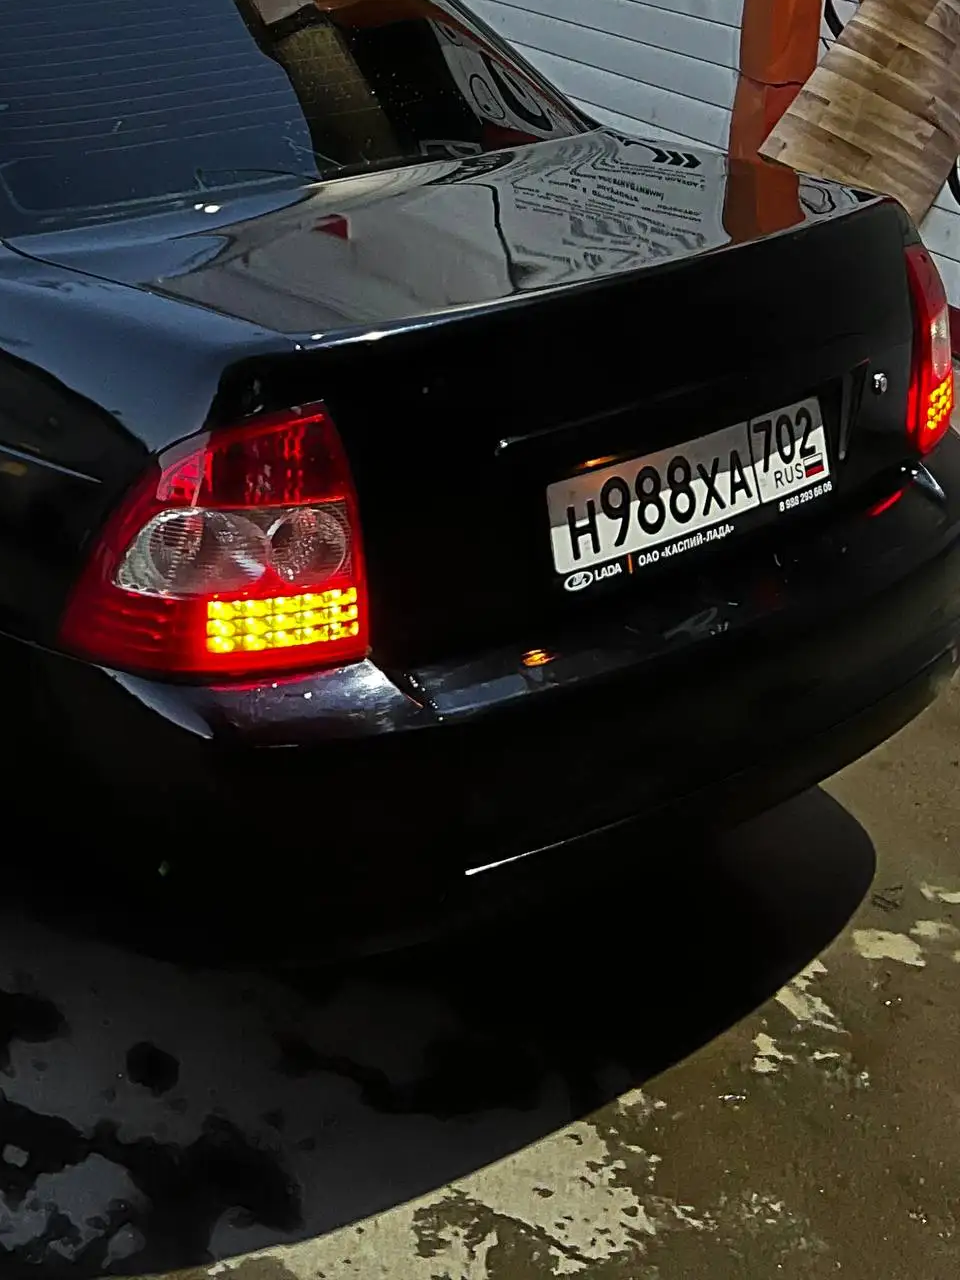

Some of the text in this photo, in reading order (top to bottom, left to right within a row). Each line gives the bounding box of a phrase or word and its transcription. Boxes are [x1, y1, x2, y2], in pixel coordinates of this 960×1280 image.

[566, 406, 817, 561] Н988ХА 702
[774, 462, 804, 488] RUS
[638, 524, 735, 567] ОАО «КАСПИЙ-ЛАДА»
[595, 562, 622, 581] LADA
